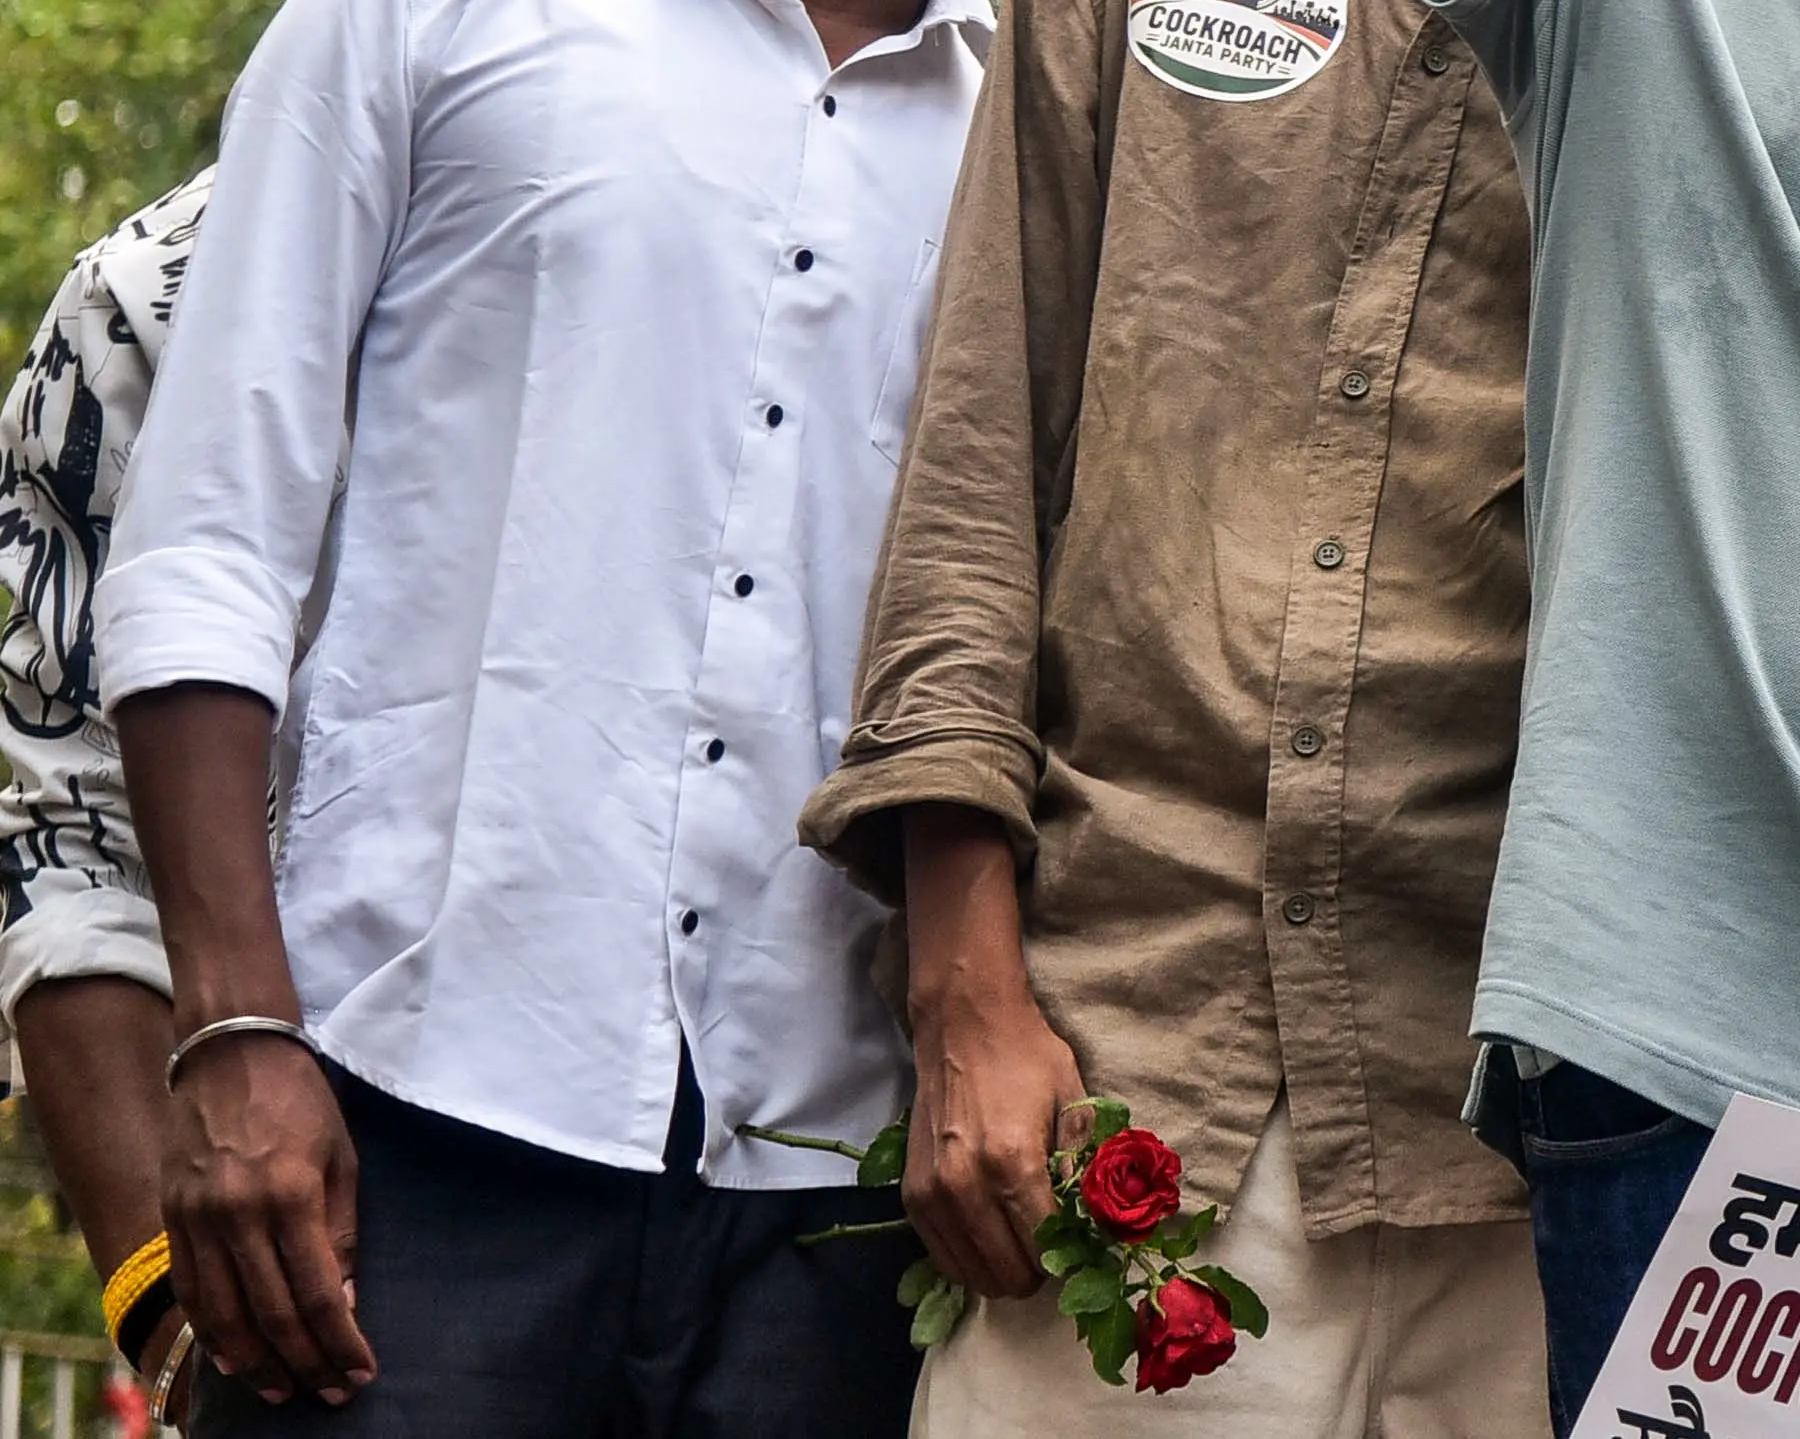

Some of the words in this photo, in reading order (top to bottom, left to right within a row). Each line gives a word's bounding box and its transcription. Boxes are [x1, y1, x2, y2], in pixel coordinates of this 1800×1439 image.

[1148, 5, 1301, 64] COCKROACH
[1160, 34, 1214, 59] JANTA
[1220, 47, 1277, 75] PARTY
